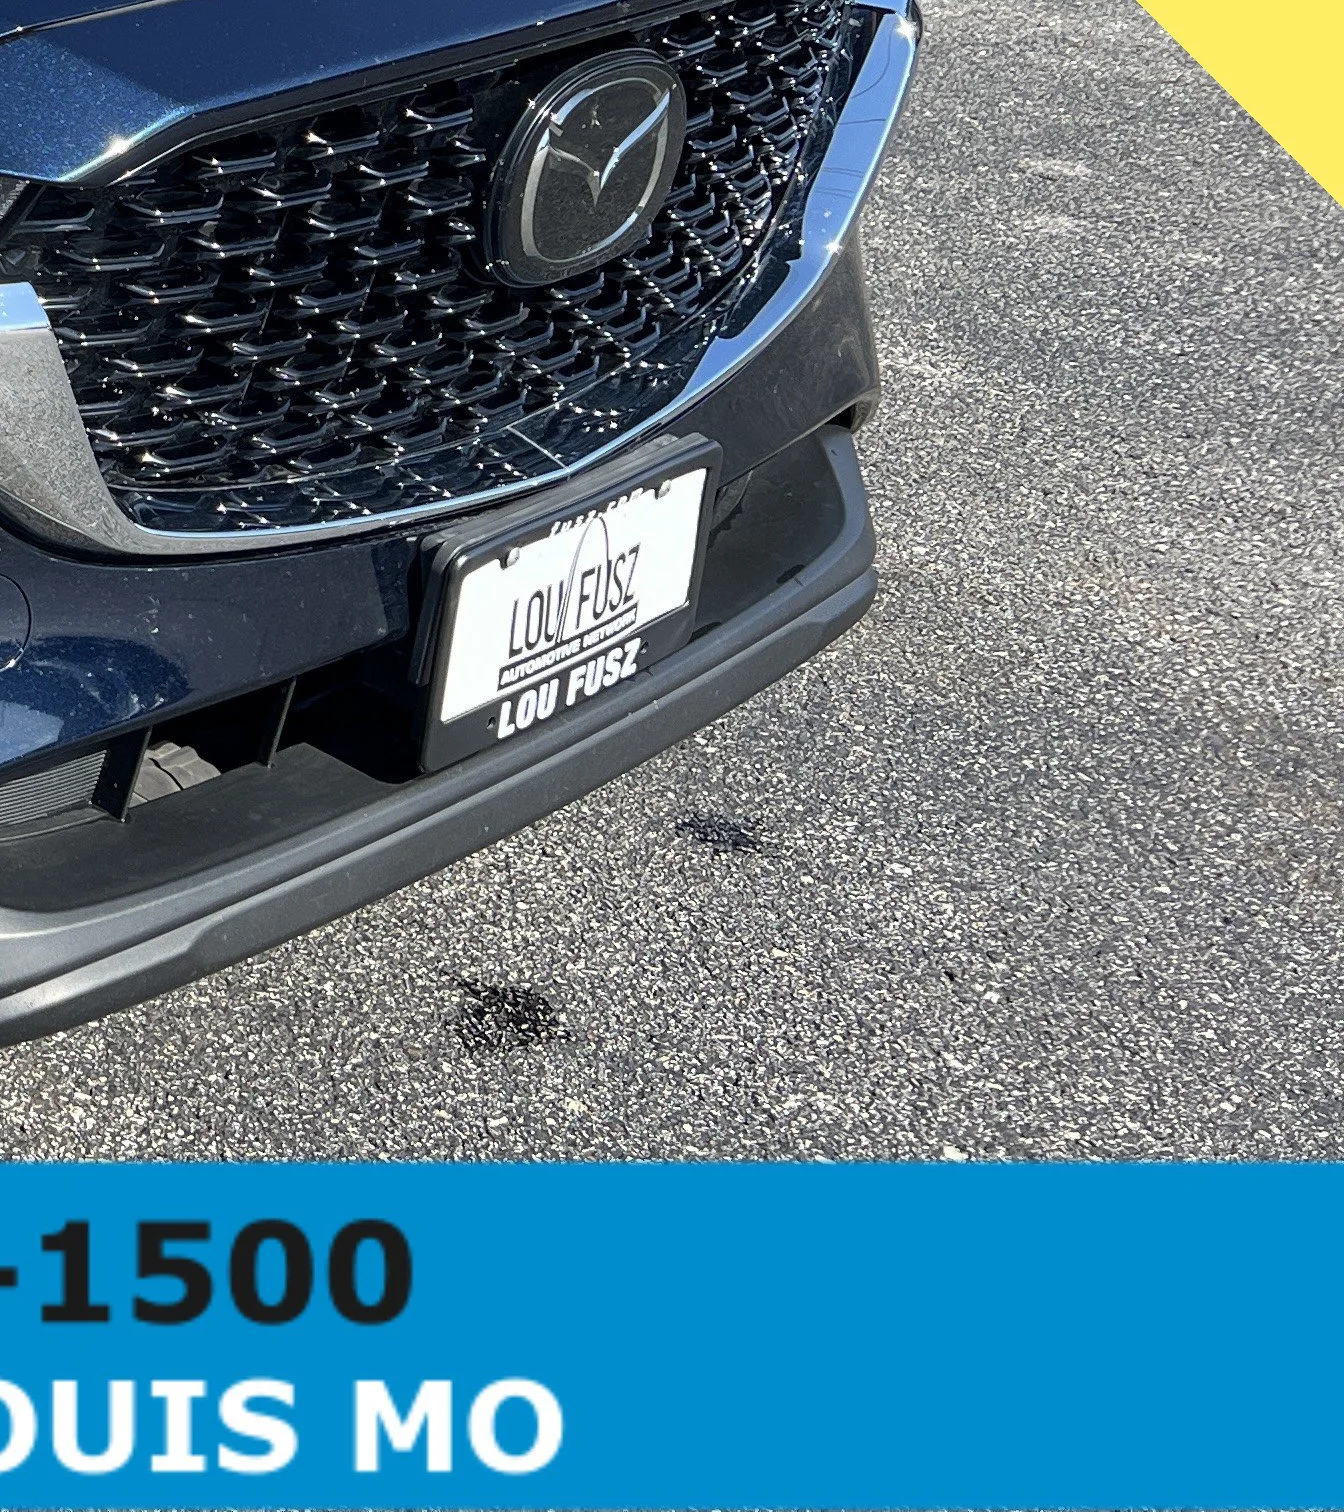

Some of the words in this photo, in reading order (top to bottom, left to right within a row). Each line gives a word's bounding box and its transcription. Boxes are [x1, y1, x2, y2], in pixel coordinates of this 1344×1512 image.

[500, 637, 582, 686] AUTOMOTIVE
[582, 607, 637, 648] NETWORK
[508, 578, 564, 659] LOU
[575, 541, 642, 630] FUSZ
[497, 678, 560, 740] LOU
[565, 637, 642, 707] FUSZ
